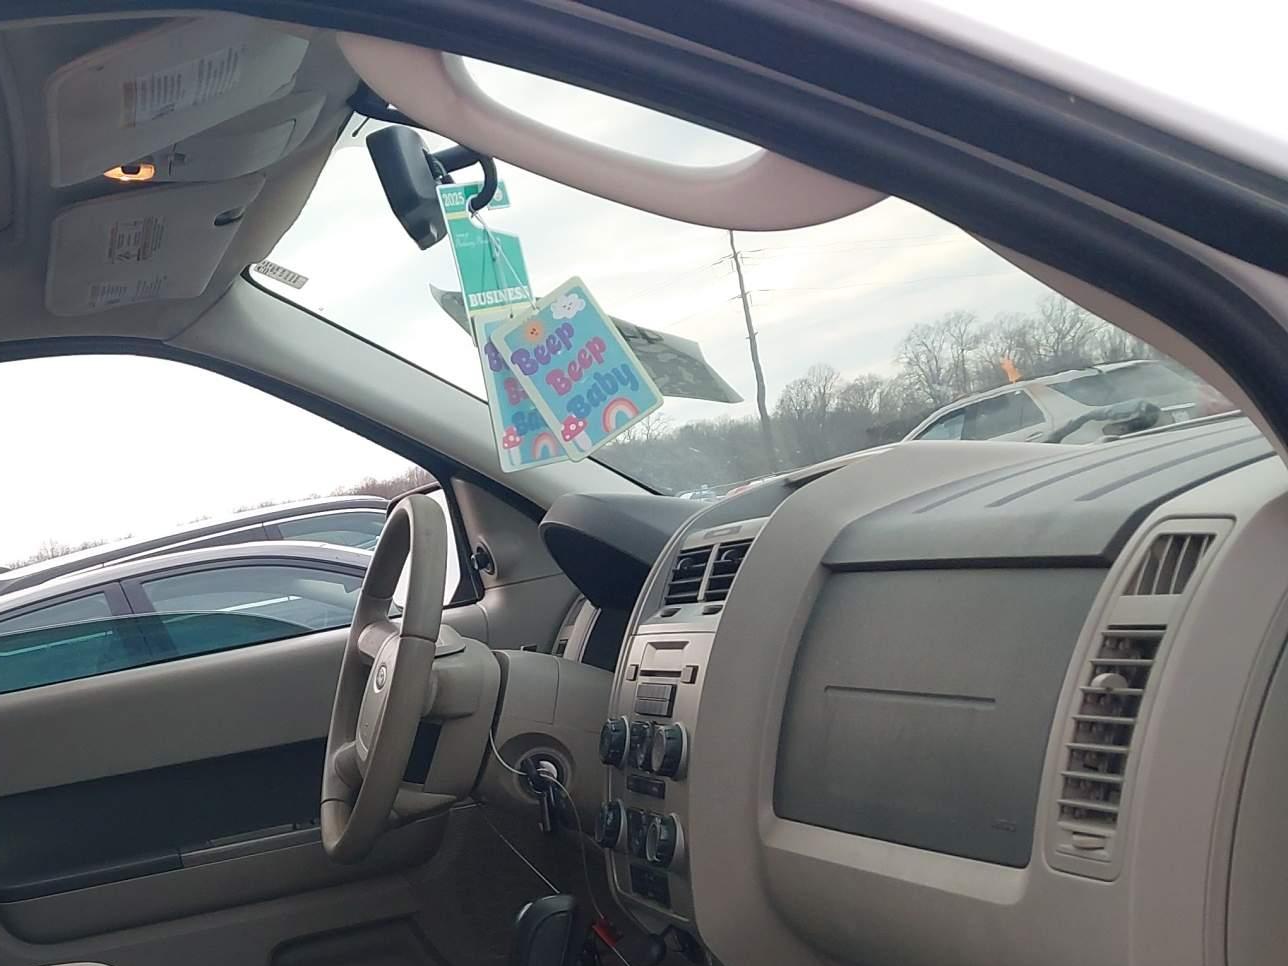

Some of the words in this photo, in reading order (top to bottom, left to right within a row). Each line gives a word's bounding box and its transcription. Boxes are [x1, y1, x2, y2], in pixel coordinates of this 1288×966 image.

[511, 322, 574, 376] Beep
[545, 336, 606, 396] Beep
[566, 363, 640, 419] Baby
